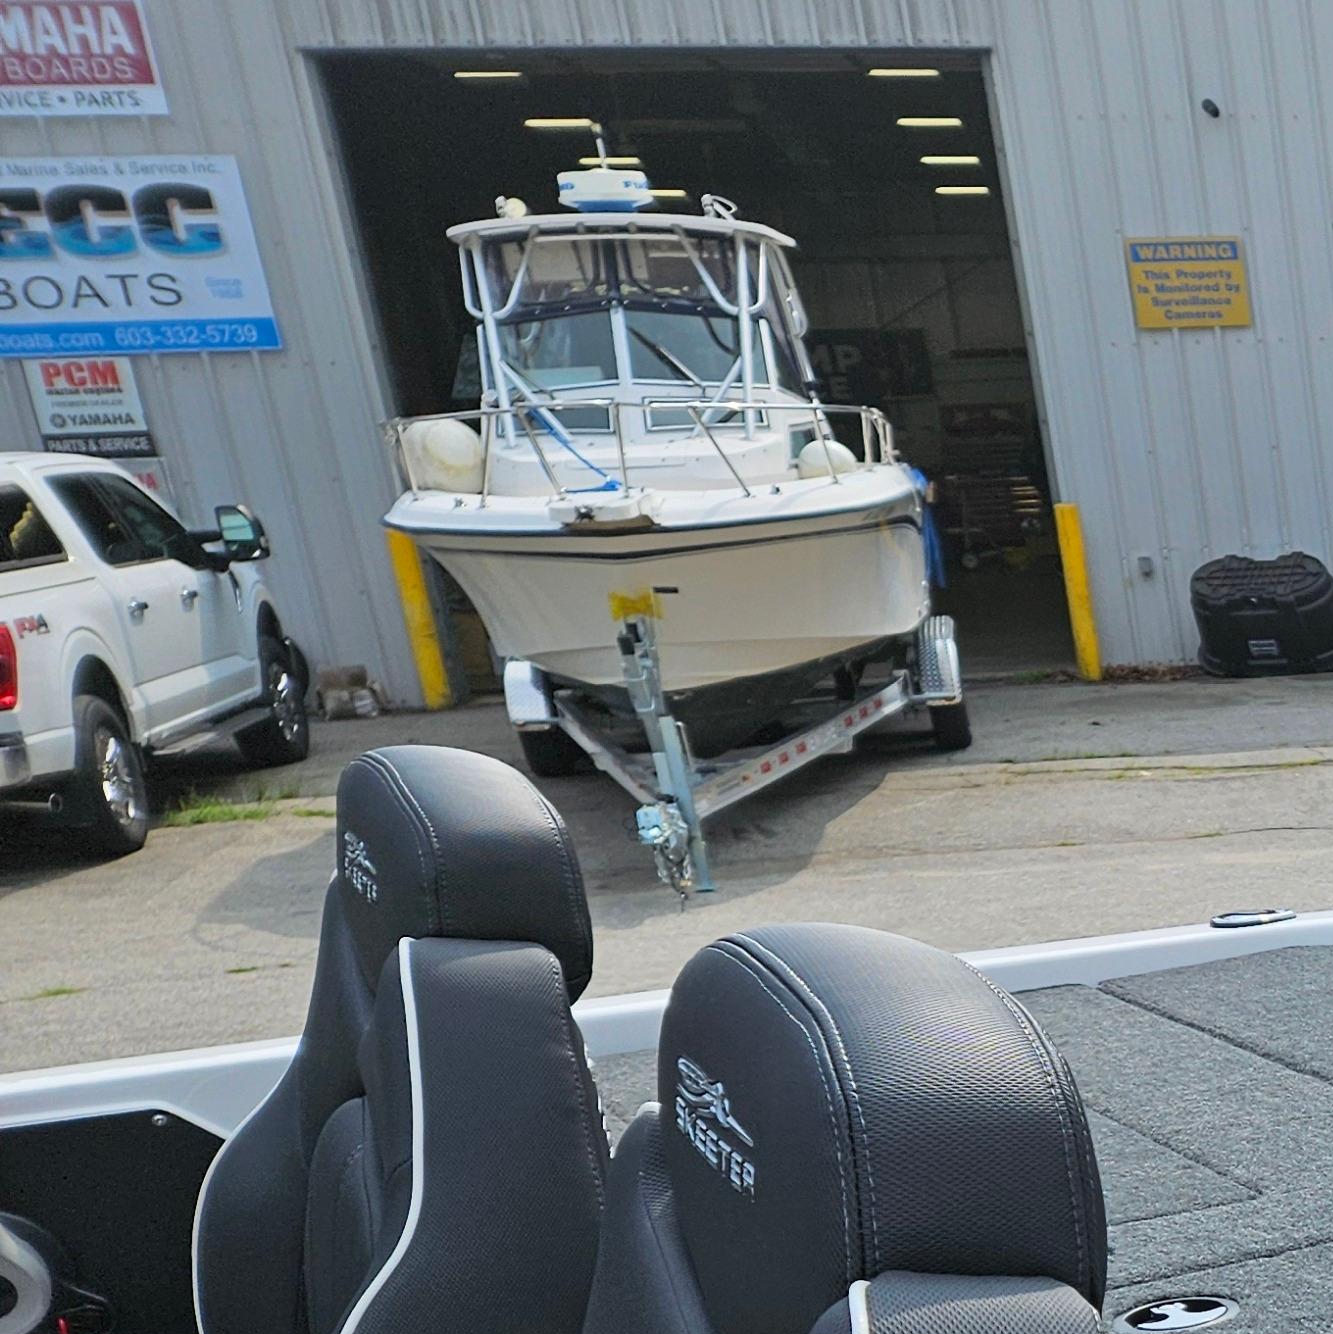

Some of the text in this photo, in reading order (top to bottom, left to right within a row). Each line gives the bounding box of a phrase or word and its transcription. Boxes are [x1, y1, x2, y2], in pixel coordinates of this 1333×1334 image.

[74, 89, 142, 107] PARTS
[64, 162, 109, 176] Sales
[129, 160, 187, 175] Service
[1135, 245, 1232, 258] WARNING
[1175, 269, 1232, 280] Property
[1164, 310, 1223, 320] Cameras
[115, 323, 258, 346] 603-332-5739
[40, 361, 121, 387] PCM
[67, 413, 136, 426] YAMAHA
[47, 440, 86, 452] PARTS
[99, 436, 150, 450] SERVICE
[675, 1095, 756, 1204] SKEETER
